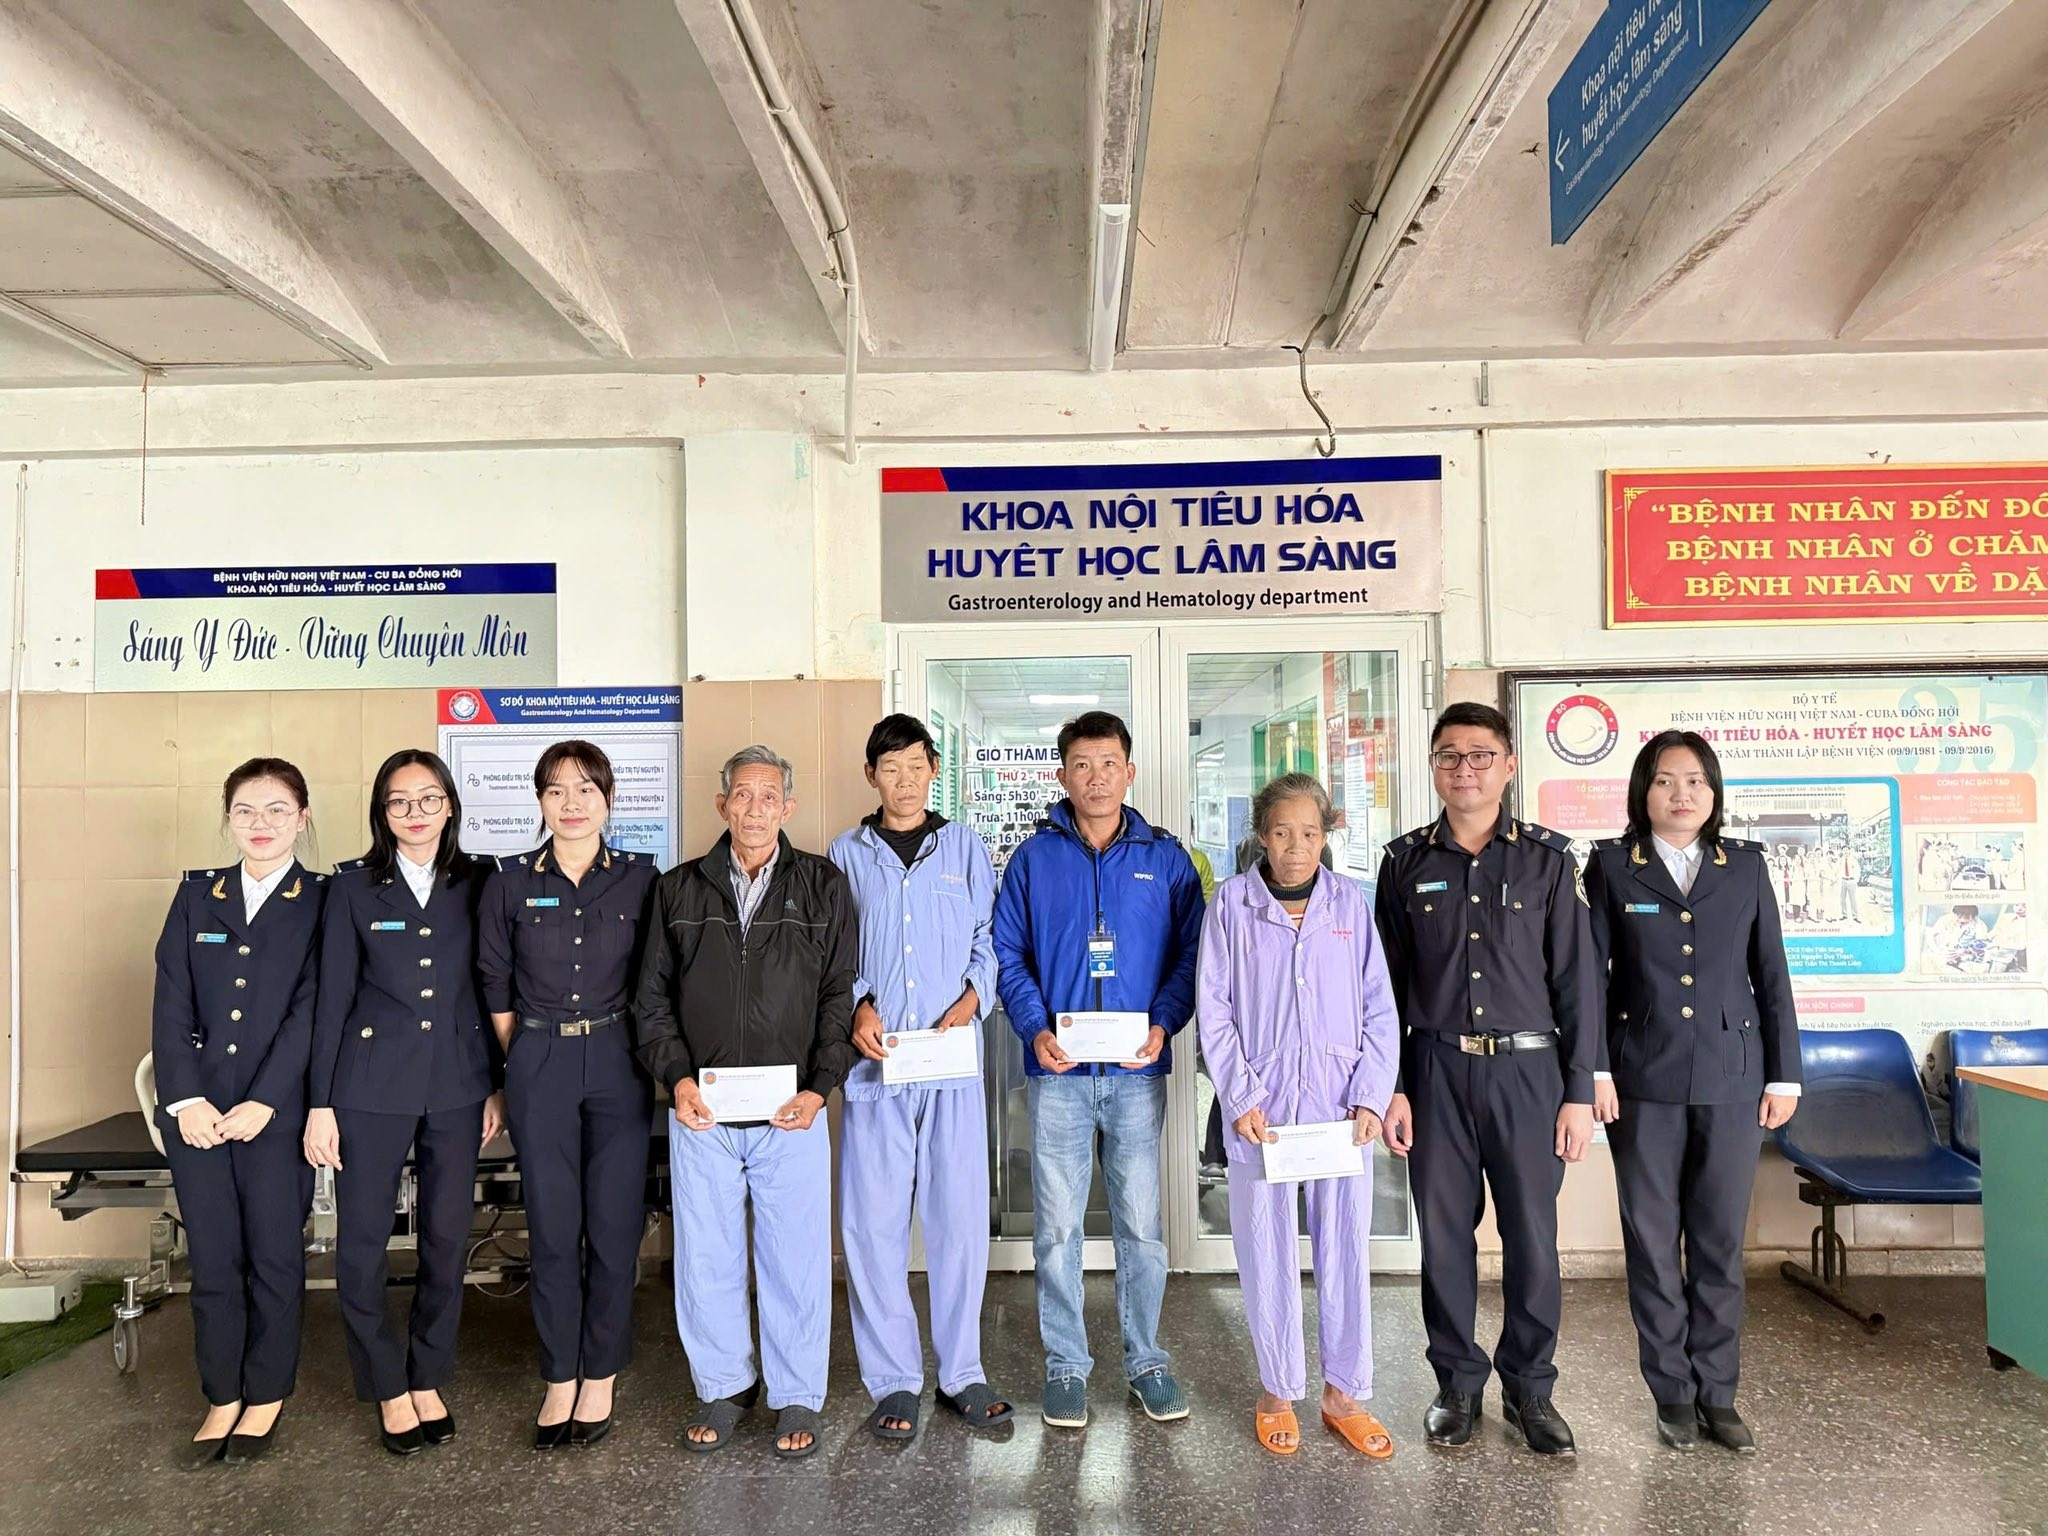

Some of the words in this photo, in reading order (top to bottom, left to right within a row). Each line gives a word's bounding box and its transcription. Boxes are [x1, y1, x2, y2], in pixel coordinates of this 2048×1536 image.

[1581, 63, 1606, 111] Khoa
[1608, 29, 1624, 75] nội
[1626, 5, 1646, 48] tiêu
[1582, 92, 1608, 149] huyết
[1609, 72, 1629, 112] học
[1631, 43, 1651, 83] lâm
[1653, 0, 1683, 54] sàng
[962, 500, 1074, 531] KHOA
[1089, 493, 1157, 533] NỘI
[1172, 490, 1262, 527] TIÊU
[1275, 487, 1364, 525] HÓA
[1788, 495, 1897, 523] NHÂN
[1909, 489, 1991, 520] ĐẾN
[1666, 534, 1774, 565] BỆNH
[1786, 532, 1895, 559] NHÂN
[1908, 529, 1934, 557] Ở
[1078, 545, 1161, 581] HỌC
[1175, 538, 1266, 575] LÂM
[1278, 535, 1397, 572] SÀNG
[213, 571, 240, 583] BỆNH
[242, 570, 265, 583] VIỆN
[267, 570, 289, 581] HỮU
[291, 571, 318, 582] NGHỊ
[319, 569, 340, 582] VIỆT
[342, 571, 366, 580] NAM
[374, 571, 389, 579] CU
[391, 571, 406, 580] BA
[442, 568, 462, 579] HỚI
[1684, 571, 1792, 601] BỆNH
[1805, 569, 1913, 595] NHÂN
[1925, 561, 1978, 593] VỀ
[1992, 566, 2048, 596] DẶ
[227, 585, 257, 594] KHOA
[259, 583, 278, 595] NỘI
[280, 583, 300, 593] TIÊU
[303, 583, 326, 593] HÓA
[334, 581, 365, 592] HUYẾT
[367, 583, 391, 593] HỌC
[393, 581, 415, 592] LÂM
[416, 581, 446, 591] SÀNG
[948, 592, 1103, 614] Gastroenterology
[1108, 591, 1141, 609] and
[1146, 589, 1256, 610] Hematology
[1259, 587, 1368, 609] department
[123, 619, 185, 672] Sáng
[193, 617, 220, 673] Y
[227, 617, 278, 662] Đức
[299, 616, 369, 669] Vững
[378, 614, 466, 667] Chuyên
[472, 613, 529, 658] Môn
[500, 696, 511, 707] SƠ
[525, 697, 547, 706] KHOA
[548, 695, 562, 708] NỘI
[562, 695, 579, 706] TIÊU
[580, 694, 596, 705] HÓA
[600, 693, 625, 705] HUYẾT
[626, 695, 642, 707] HỌC
[643, 694, 659, 704] LÂM
[660, 693, 680, 704] SÀNG
[1792, 693, 1808, 706] BỘ
[1811, 695, 1818, 704] Y
[1821, 692, 1837, 704] TẾ
[520, 709, 573, 717] Gastroenterology
[587, 708, 623, 716] Hematology
[624, 708, 660, 716] Department
[1671, 710, 1703, 723] BỆNH
[1706, 709, 1735, 722] VIỆN
[1766, 710, 1797, 722] NGHỊ
[1799, 708, 1827, 721] VIỆT
[1830, 710, 1856, 719] NAM
[1866, 709, 1898, 718] CUBA
[1723, 726, 1760, 741] TIÊU
[1766, 725, 1800, 741] HÓA
[1813, 721, 1867, 740] HUYẾT
[1872, 726, 1905, 742] HỌC
[1909, 722, 1943, 738] LÂM
[1947, 722, 1993, 738] SÀNG
[976, 745, 1001, 761] GIỜ
[1004, 745, 1048, 761] THĂM
[1725, 747, 1750, 759] NĂM
[1753, 746, 1793, 758] THÀNH
[1822, 745, 1853, 759] BỆNH
[1856, 744, 1884, 759] VIỆN
[996, 770, 1019, 781] THỨ
[1021, 771, 1027, 781] 2
[974, 790, 1006, 804] Sáng:
[975, 812, 1004, 823] Trưa:
[979, 831, 996, 844] ối:
[998, 833, 1012, 844] 16
